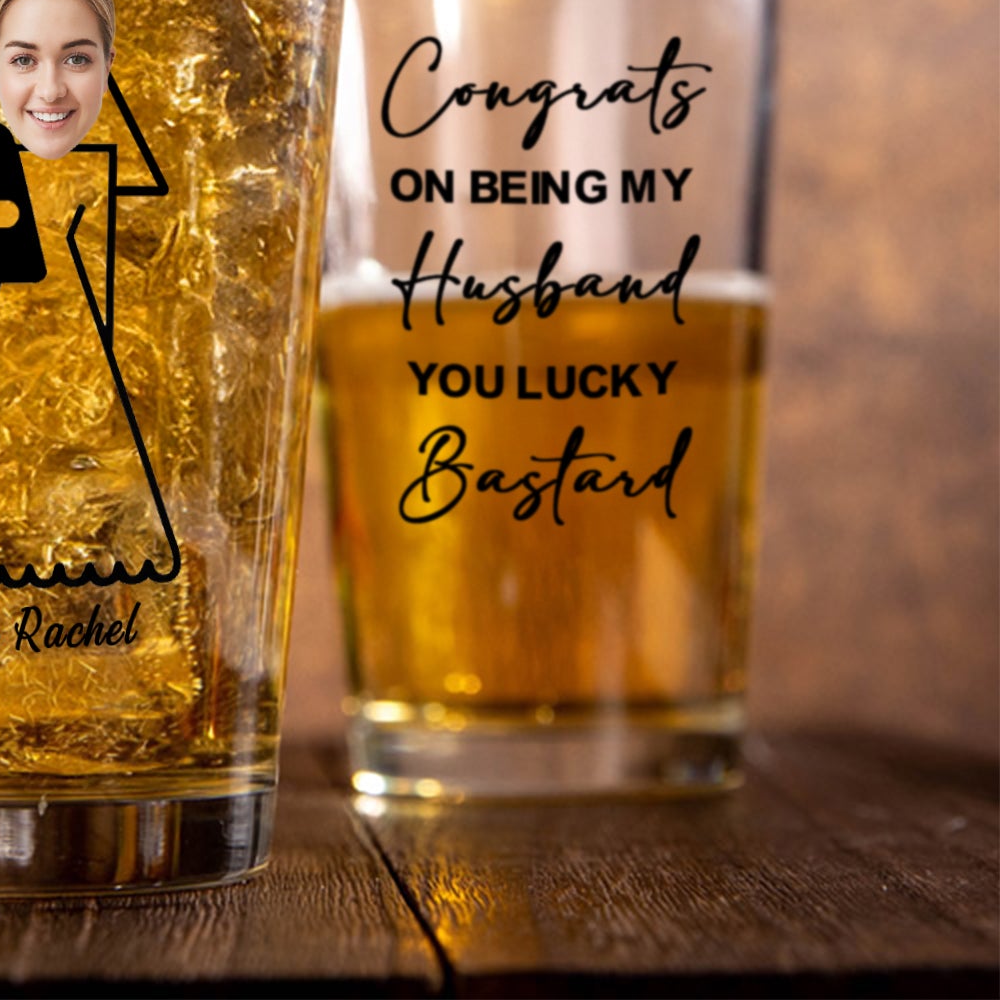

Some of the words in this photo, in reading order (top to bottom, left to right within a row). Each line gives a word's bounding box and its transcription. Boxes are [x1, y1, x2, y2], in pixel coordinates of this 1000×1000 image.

[381, 37, 713, 150] Congrats
[390, 168, 454, 204] ON
[470, 169, 608, 205] BEING
[621, 167, 693, 203] MY
[391, 230, 701, 331] Husband
[407, 361, 505, 399] YOU
[517, 360, 679, 400] LUCKY
[399, 425, 693, 525] Bastard
[14, 601, 141, 653] Rachel
